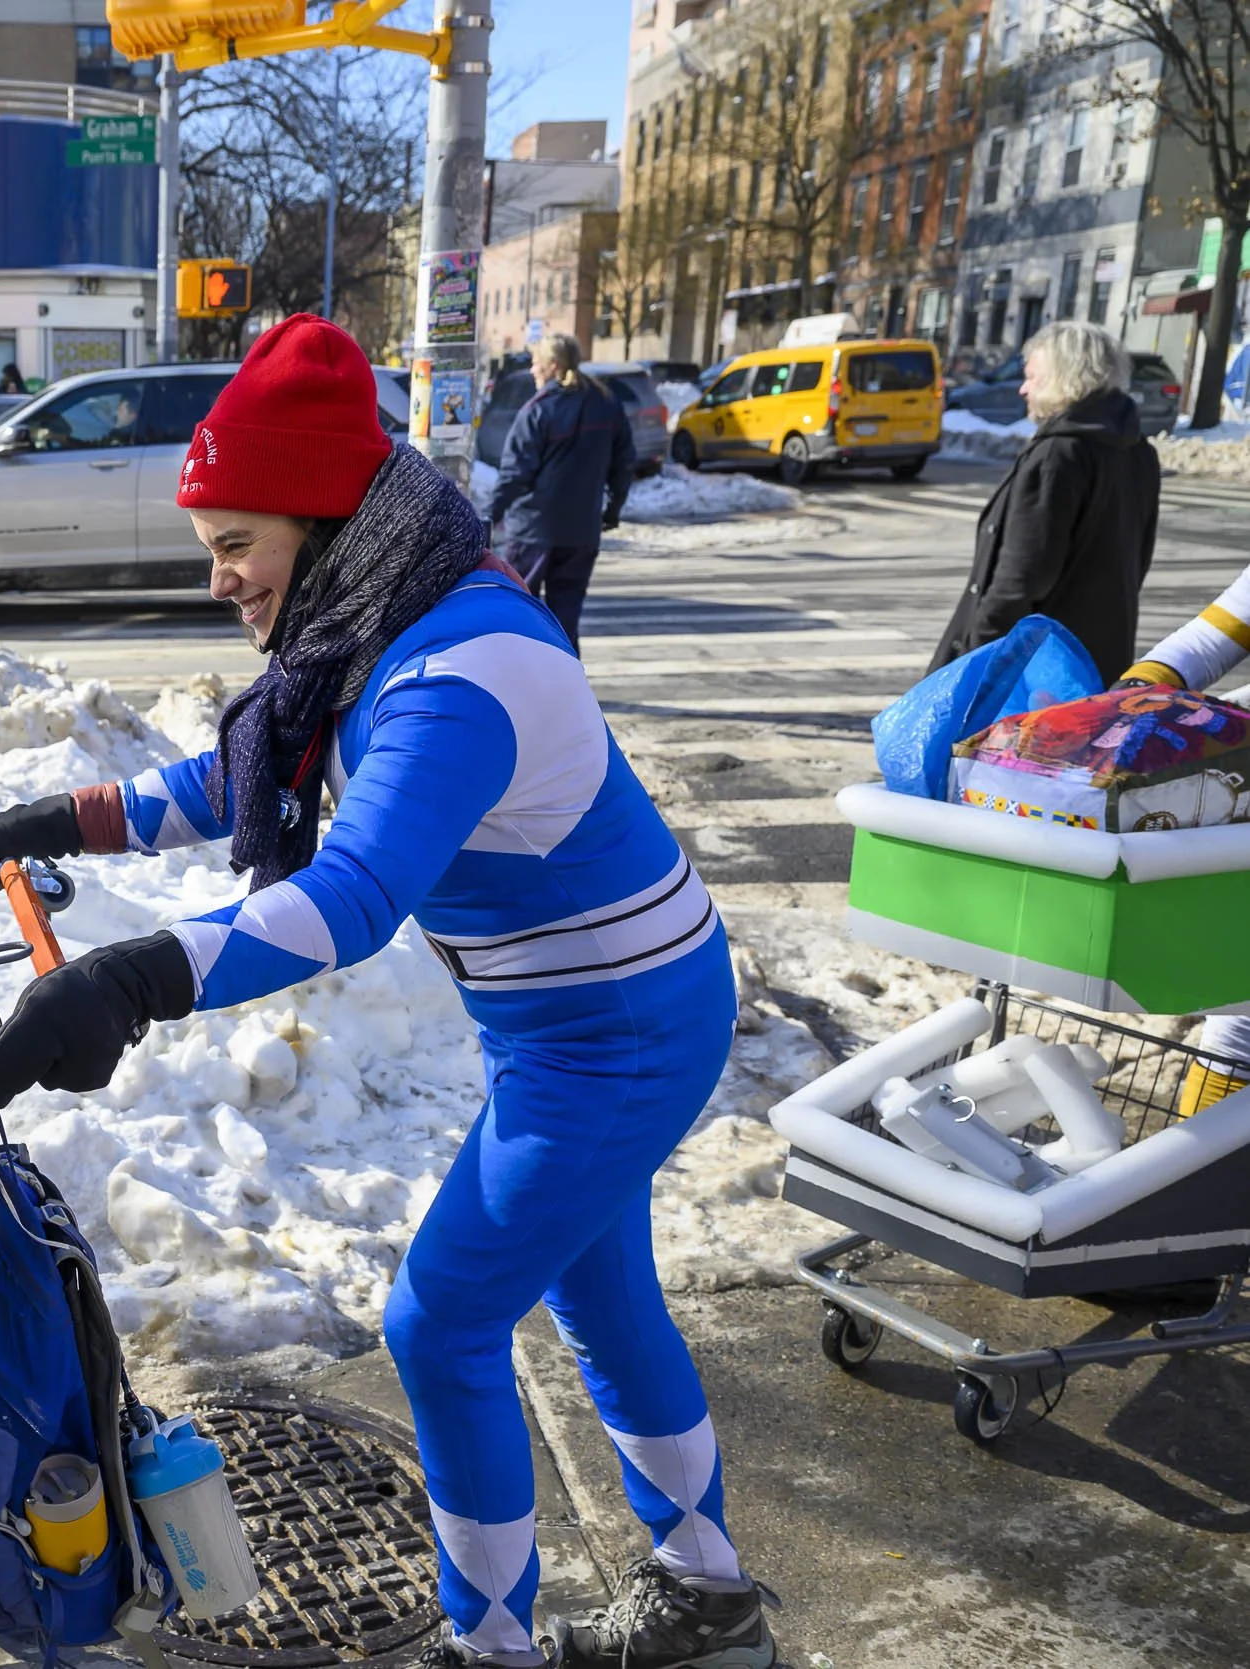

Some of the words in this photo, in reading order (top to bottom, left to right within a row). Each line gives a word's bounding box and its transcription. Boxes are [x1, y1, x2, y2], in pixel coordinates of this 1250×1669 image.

[87, 119, 138, 139] Graham
[81, 150, 117, 164] Puerto
[120, 149, 144, 161] Rico
[164, 1520, 190, 1568] Blender
